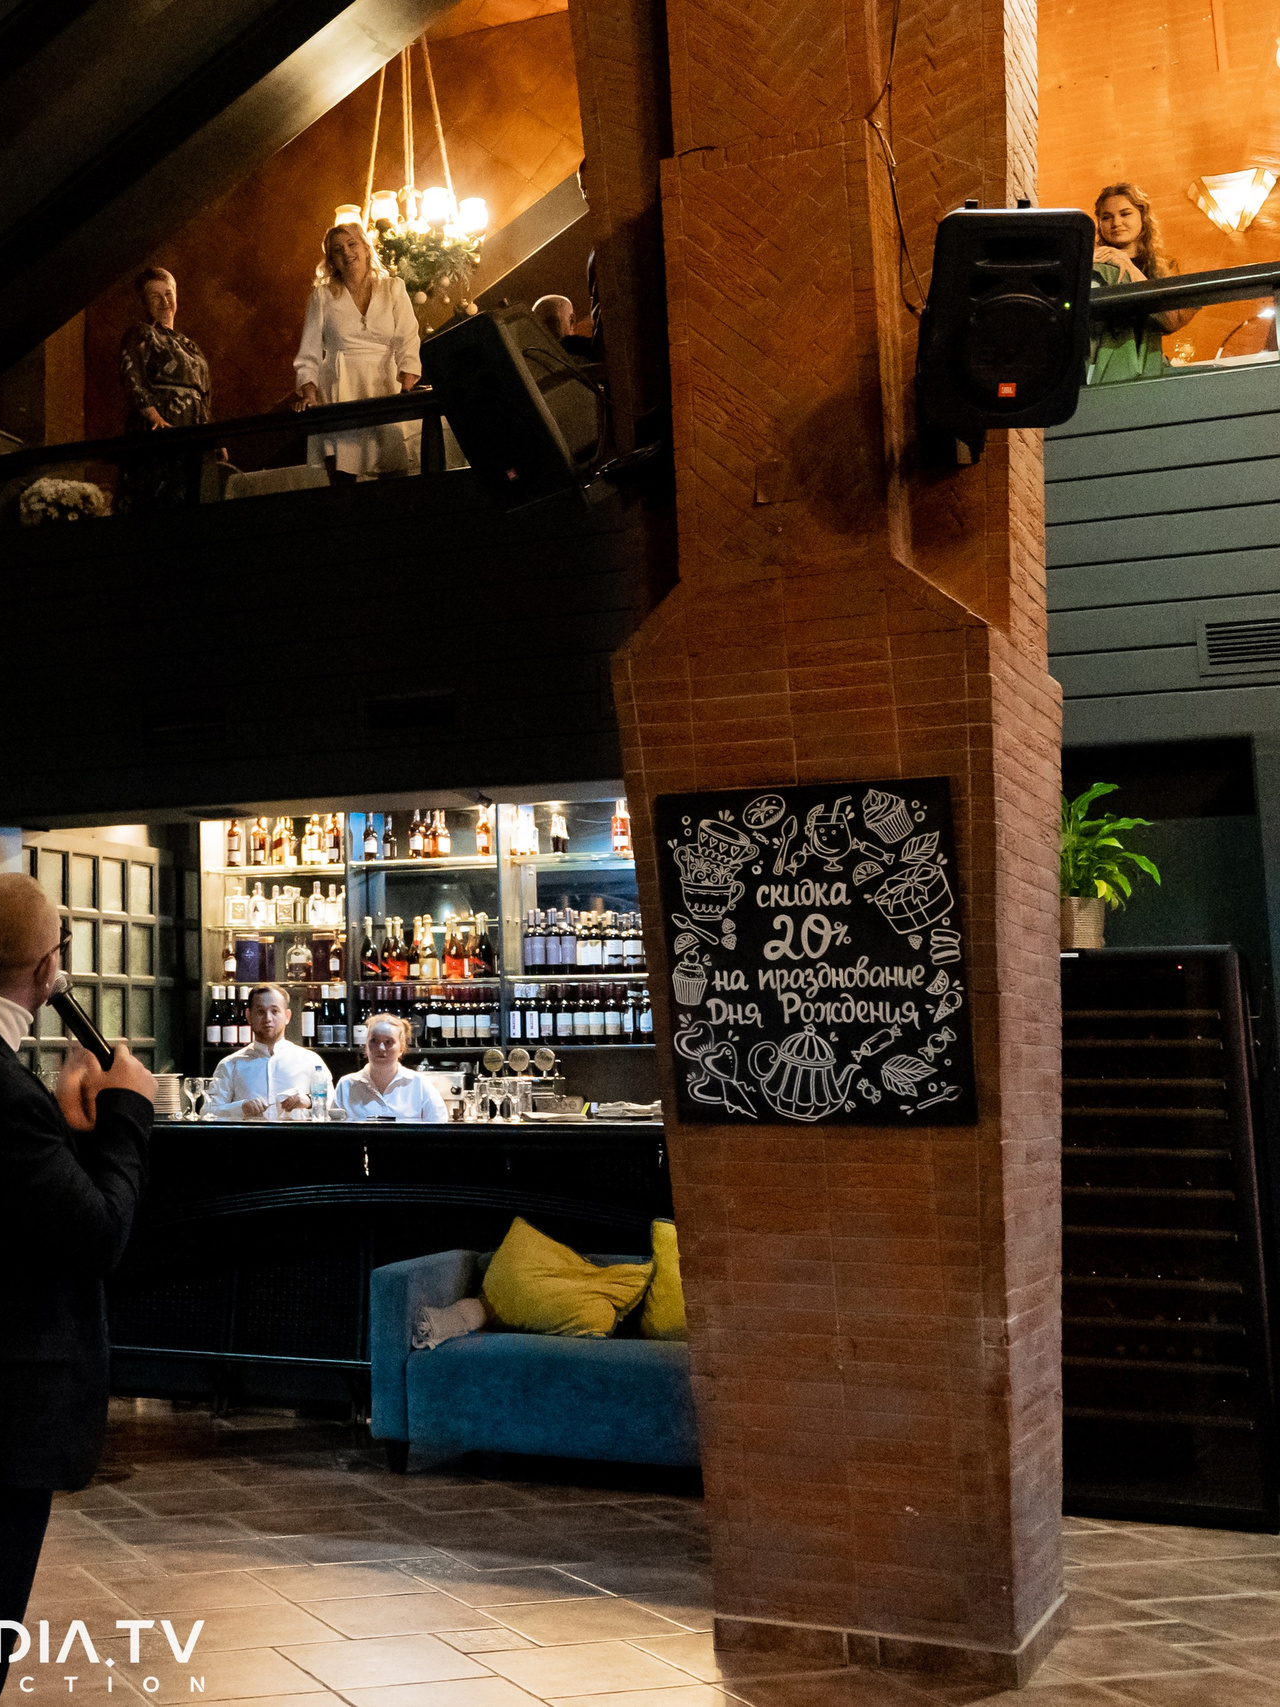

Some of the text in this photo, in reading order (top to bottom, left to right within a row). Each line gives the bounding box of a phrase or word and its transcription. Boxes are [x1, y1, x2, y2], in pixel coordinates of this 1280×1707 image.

[756, 878, 852, 908] скидка
[763, 913, 852, 961] 20%
[712, 955, 926, 1001] на празднование
[705, 992, 921, 1031] Дня Рождения
